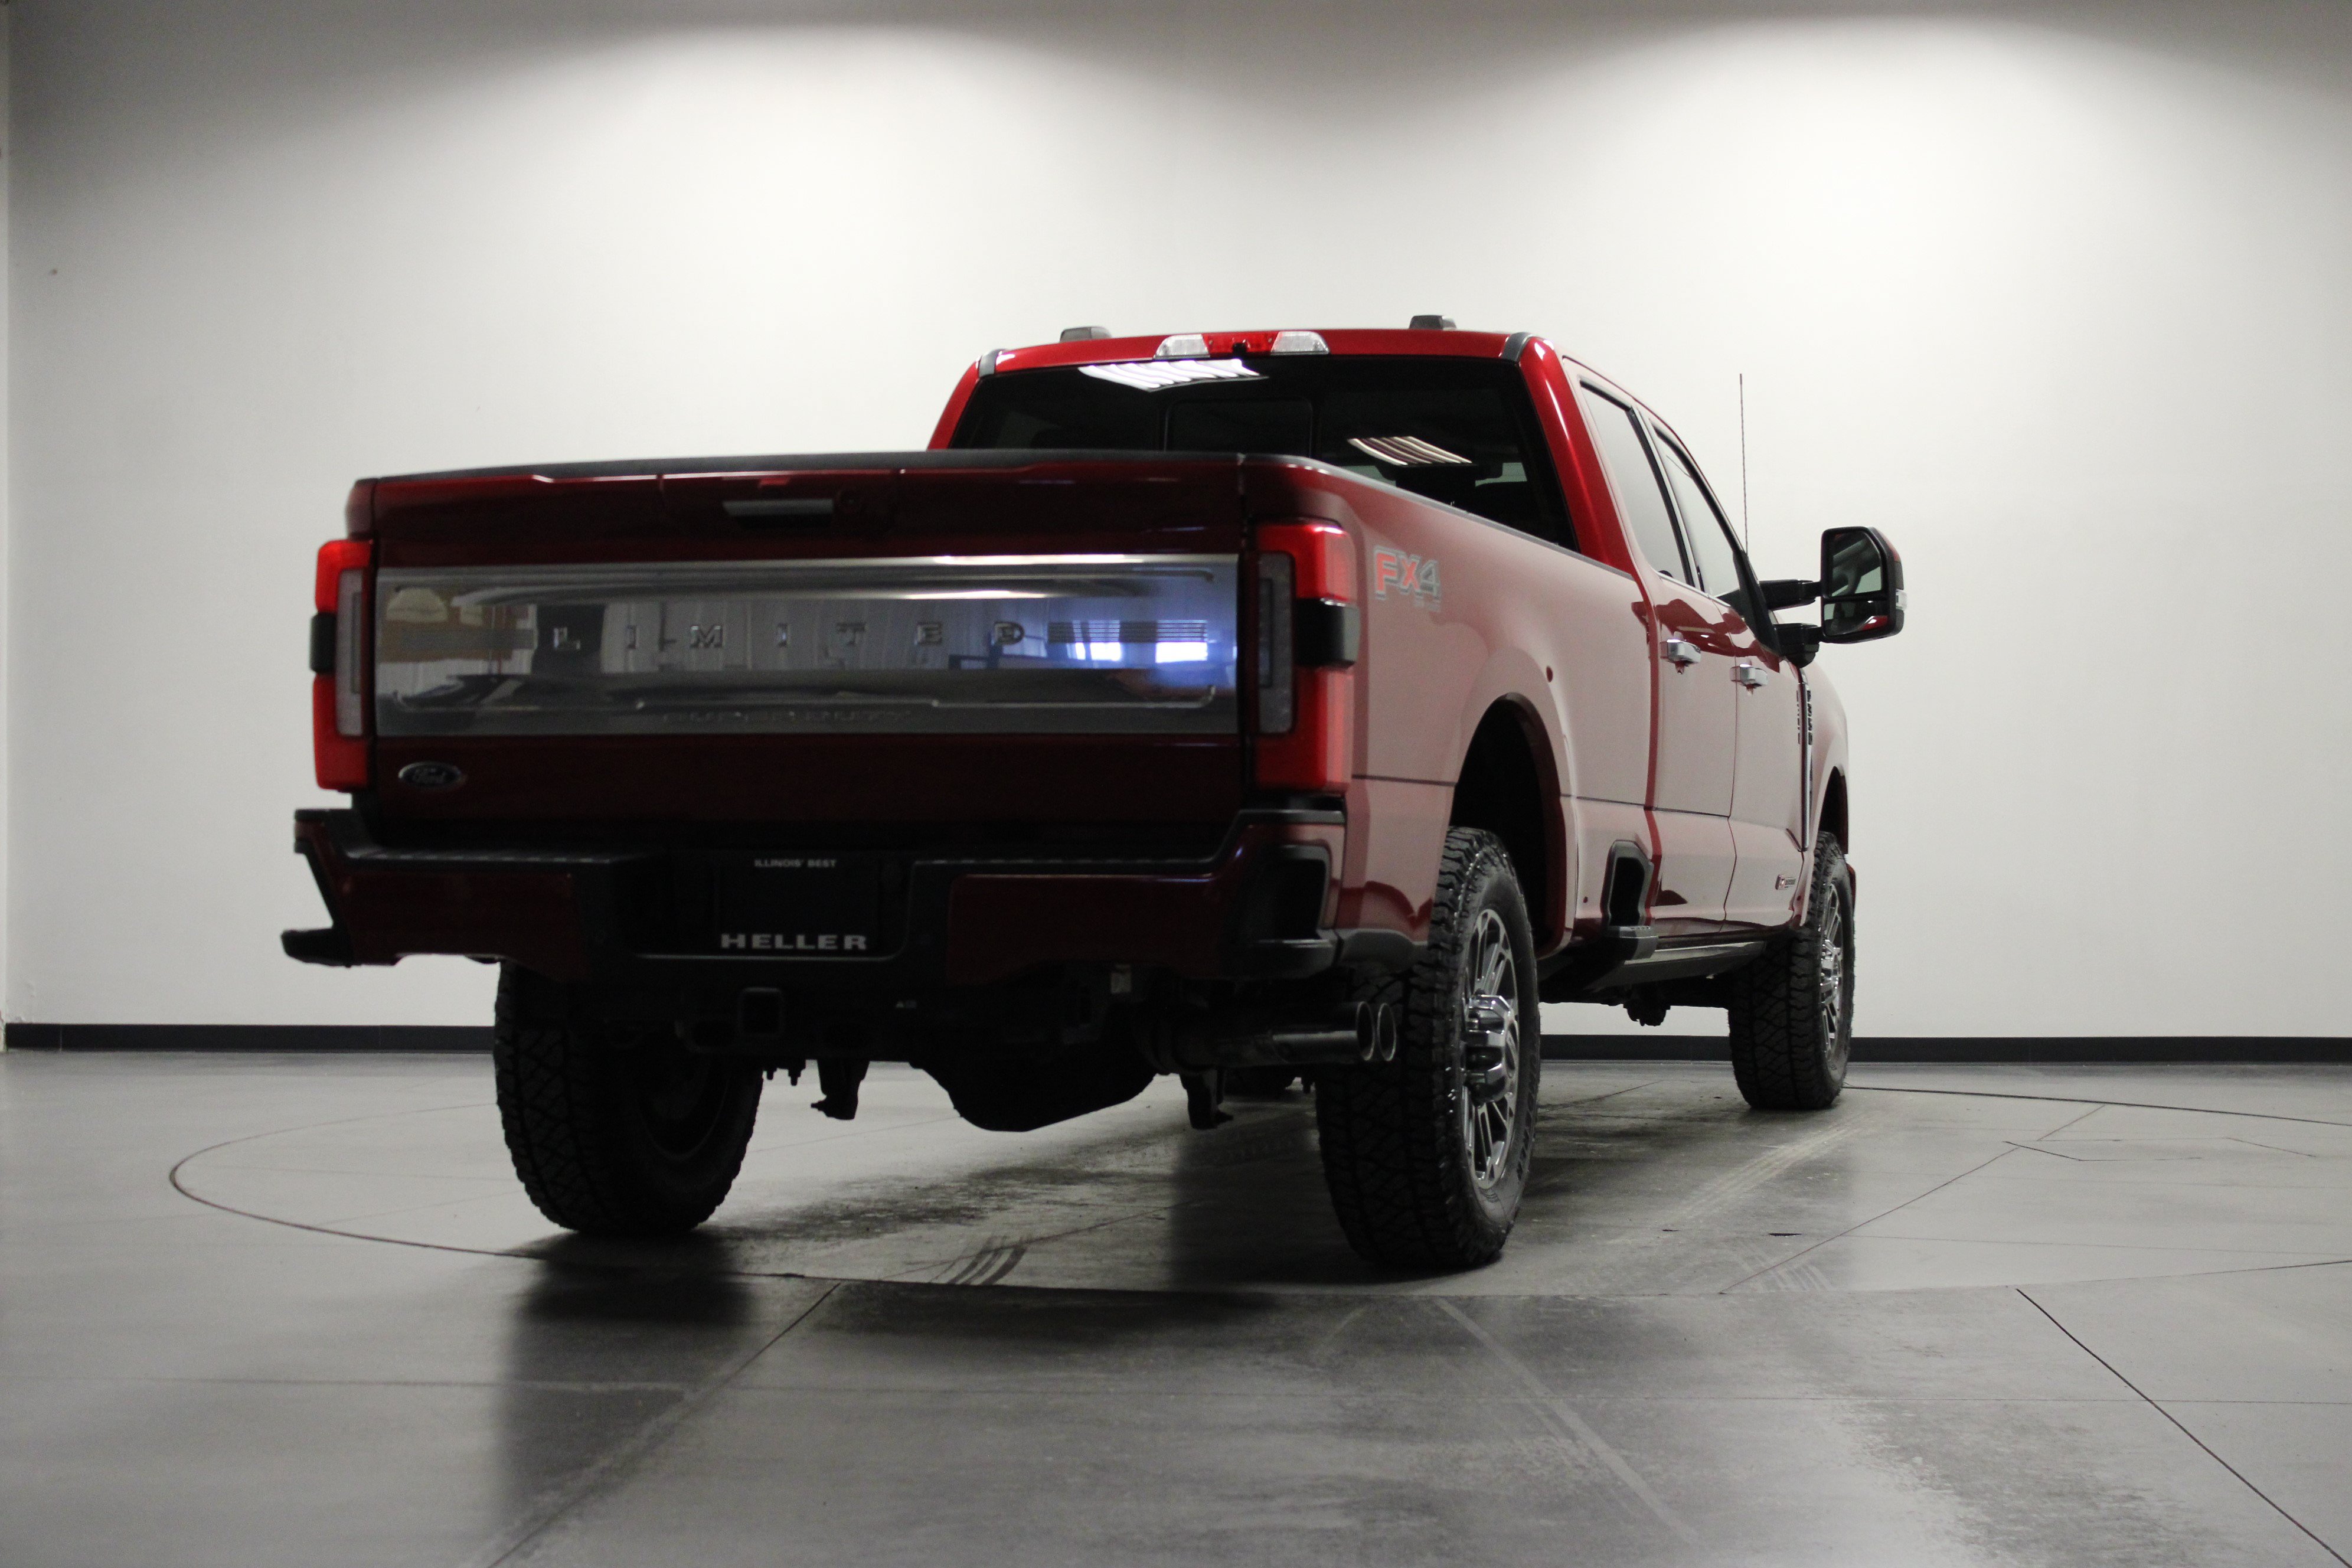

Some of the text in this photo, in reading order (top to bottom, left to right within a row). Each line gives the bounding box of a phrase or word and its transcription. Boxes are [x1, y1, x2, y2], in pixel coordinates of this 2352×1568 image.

[1373, 545, 1442, 601] FX4
[552, 621, 1025, 650] LIMITED
[806, 858, 837, 868] BEST
[720, 933, 867, 950] HELLER
